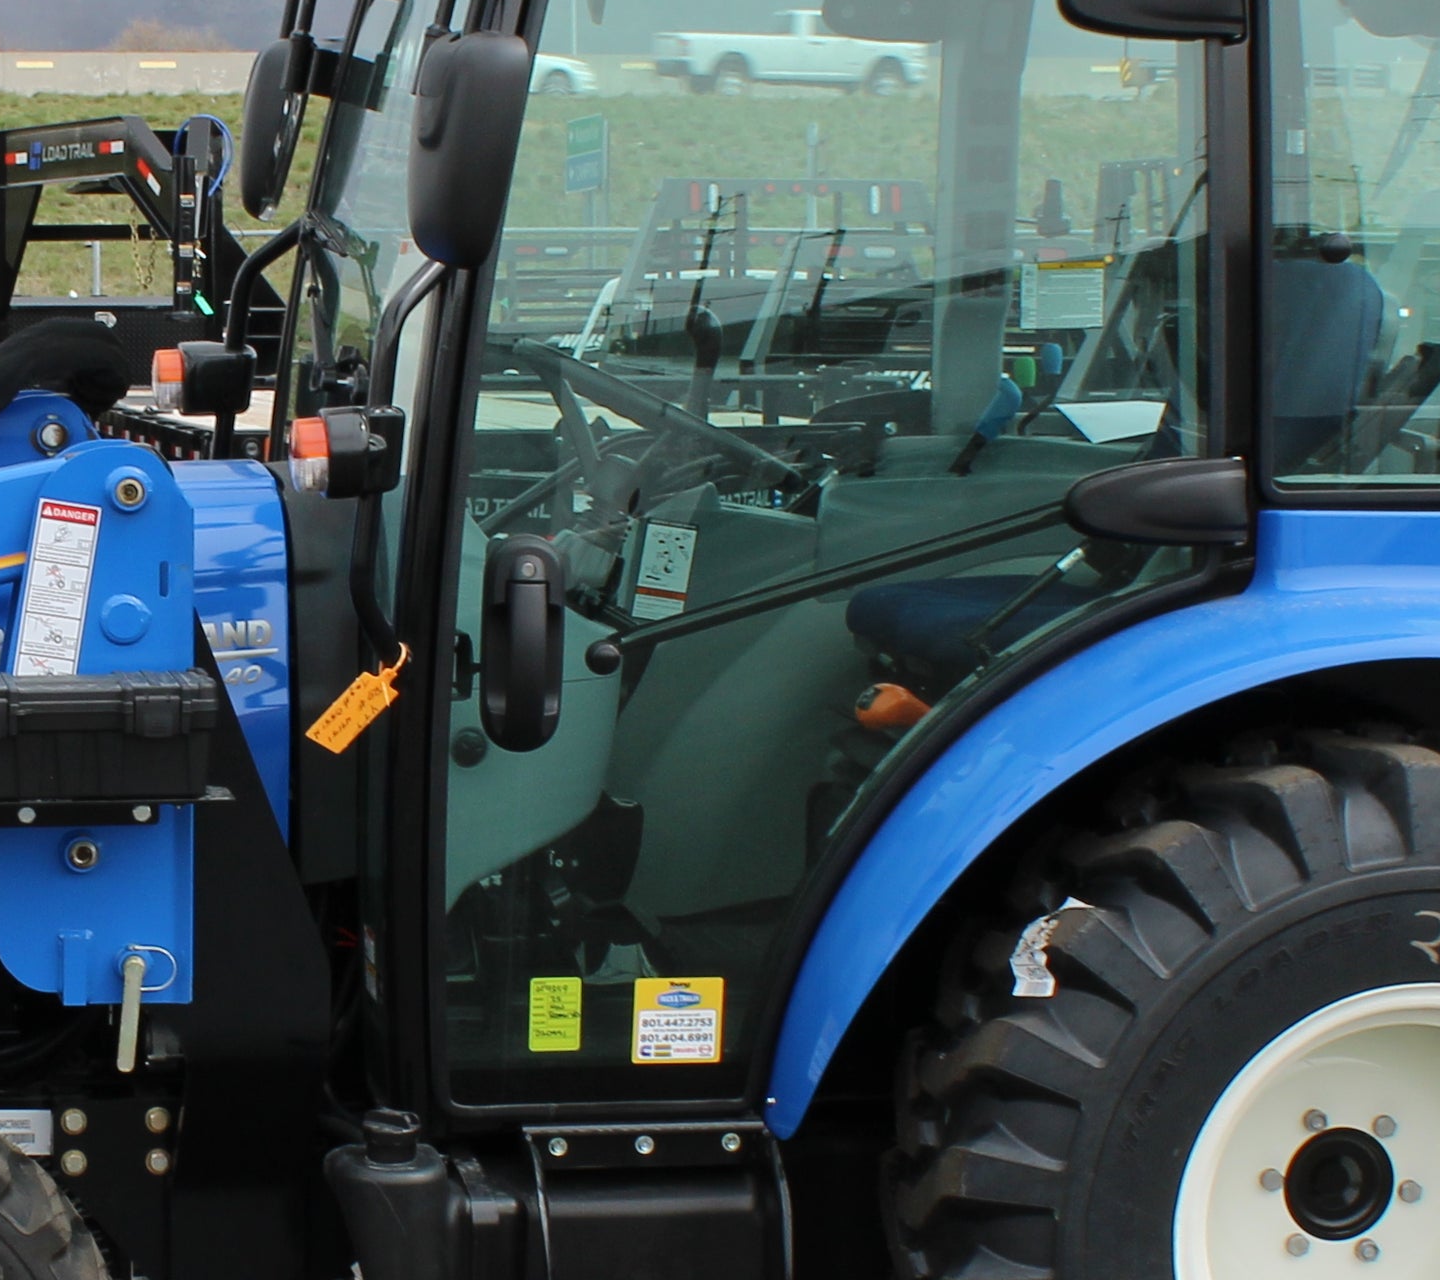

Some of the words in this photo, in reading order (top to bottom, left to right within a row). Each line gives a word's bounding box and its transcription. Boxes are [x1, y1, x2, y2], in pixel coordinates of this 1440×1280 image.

[42, 145, 67, 163] LOAD
[68, 142, 96, 160] TRAIL
[52, 508, 96, 523] DANGER
